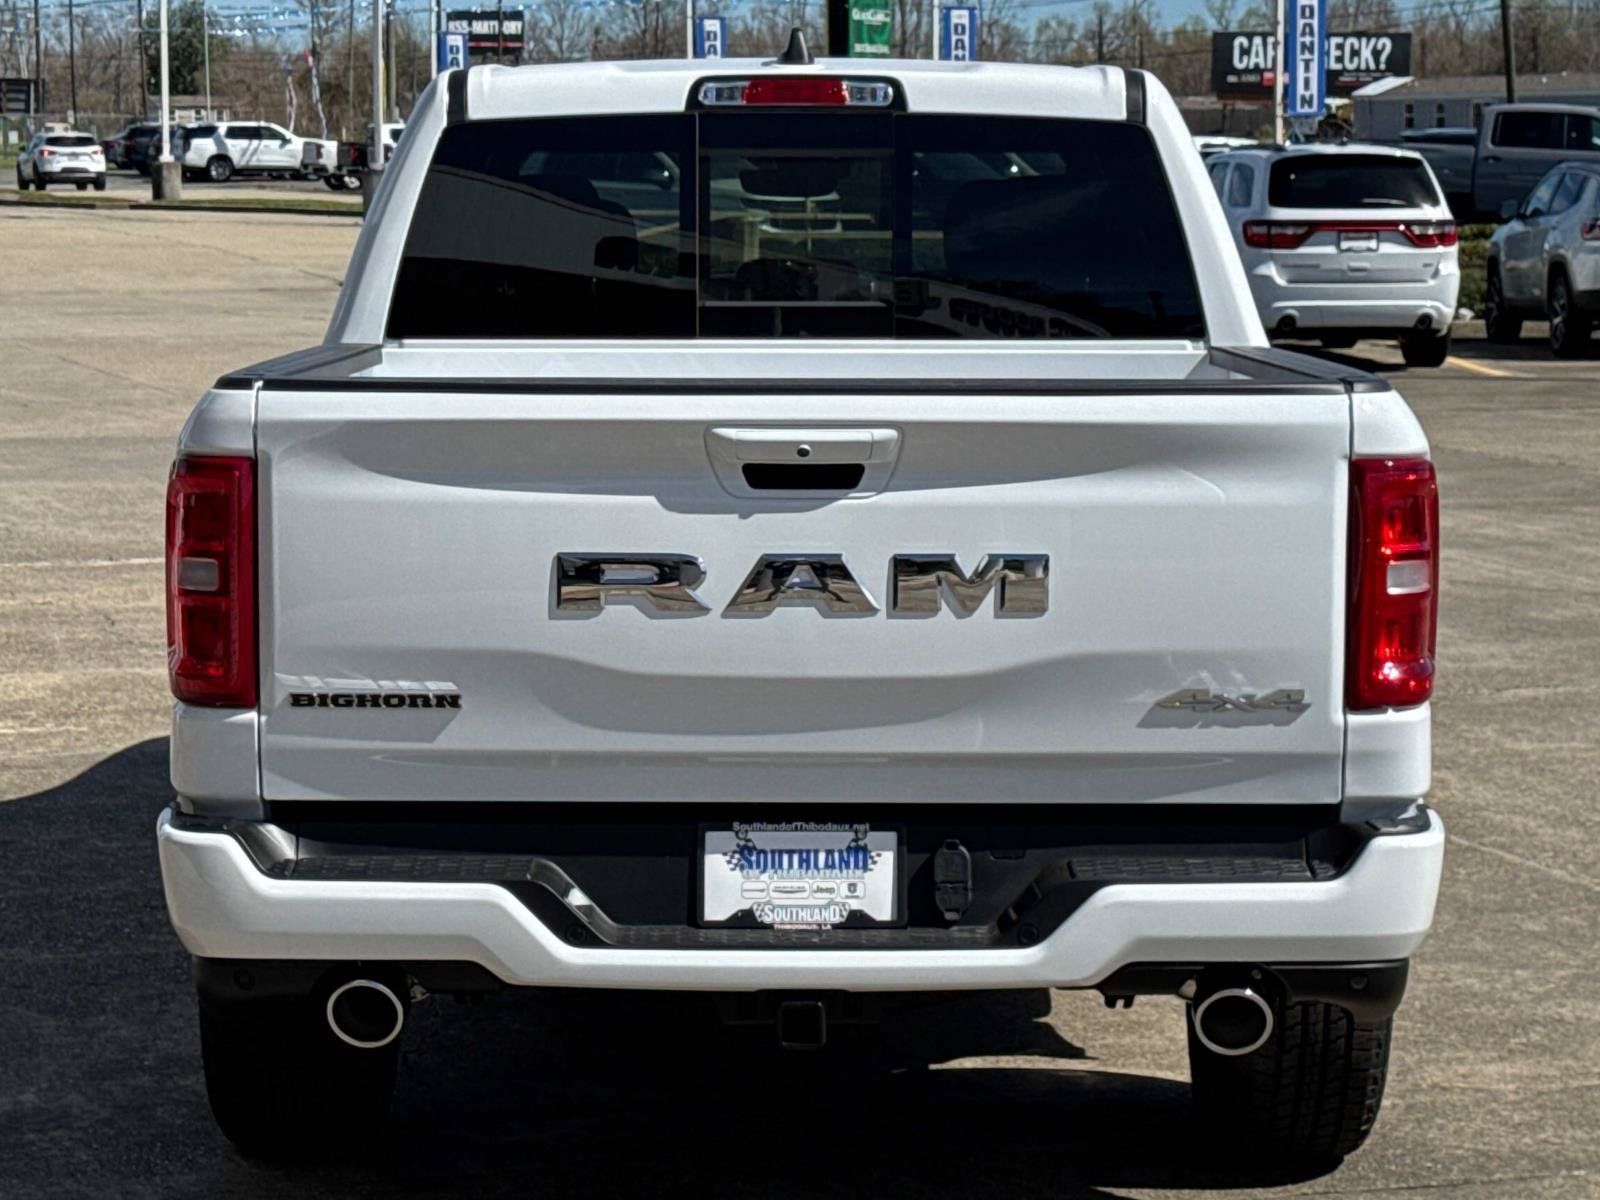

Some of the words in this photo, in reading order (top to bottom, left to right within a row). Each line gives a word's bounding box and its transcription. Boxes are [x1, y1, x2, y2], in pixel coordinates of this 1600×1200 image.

[1300, 4, 1315, 110] DANTIN
[1325, 36, 1392, 71] ECK?
[553, 552, 1049, 615] RAM
[290, 693, 462, 709] BIGHORN
[812, 885, 836, 895] Jeep
